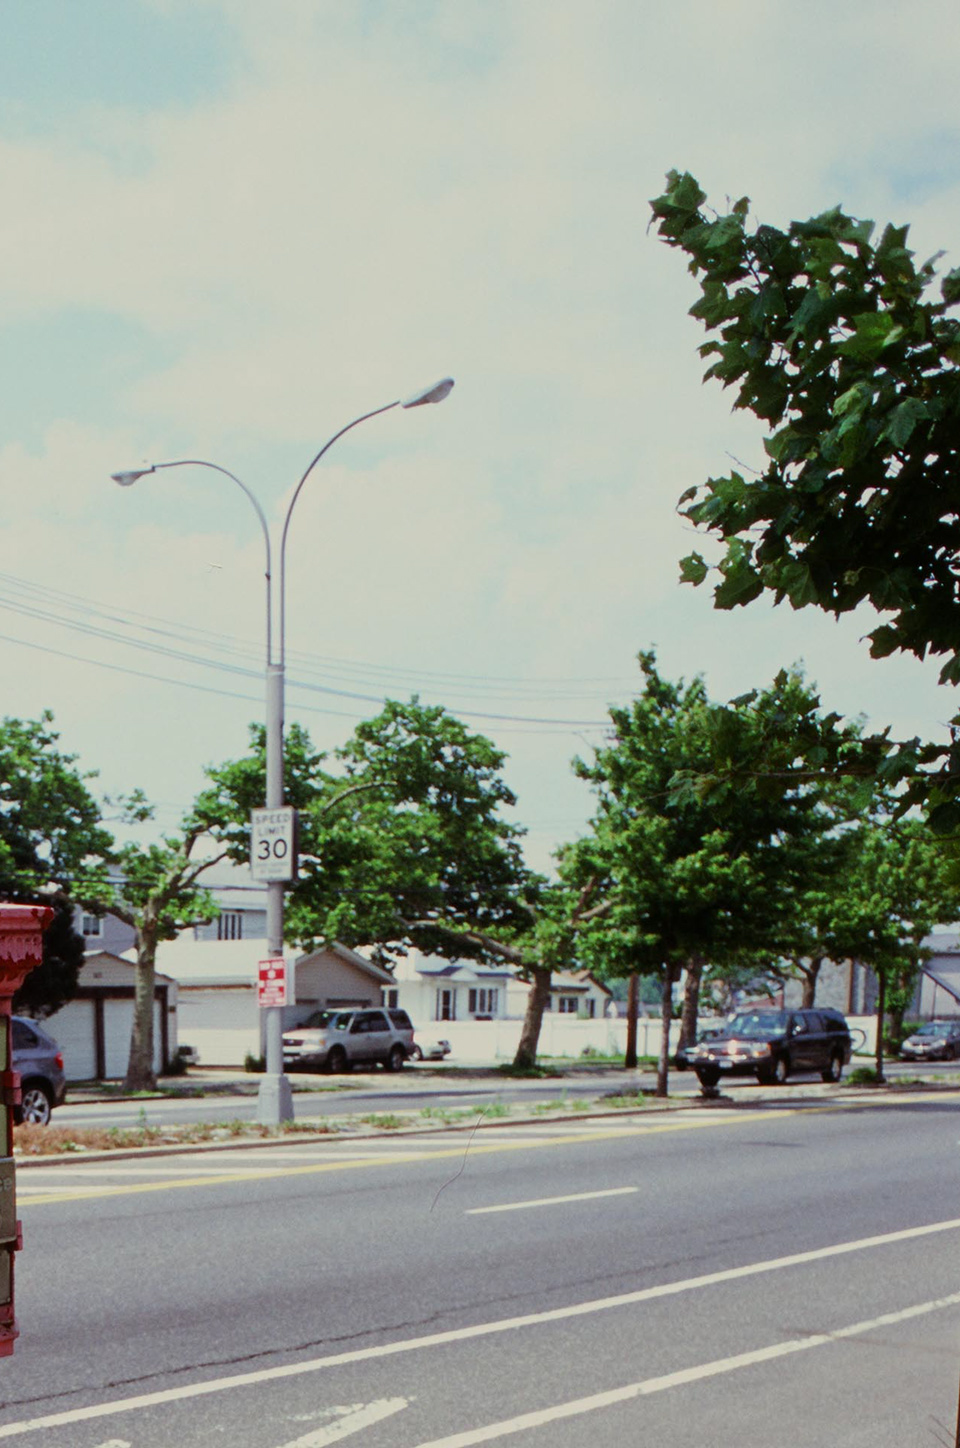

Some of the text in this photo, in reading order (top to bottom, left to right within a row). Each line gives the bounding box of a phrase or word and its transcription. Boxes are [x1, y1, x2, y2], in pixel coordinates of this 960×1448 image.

[255, 813, 290, 824] SPEED
[258, 826, 286, 838] LIMIT
[258, 839, 287, 860] 30
